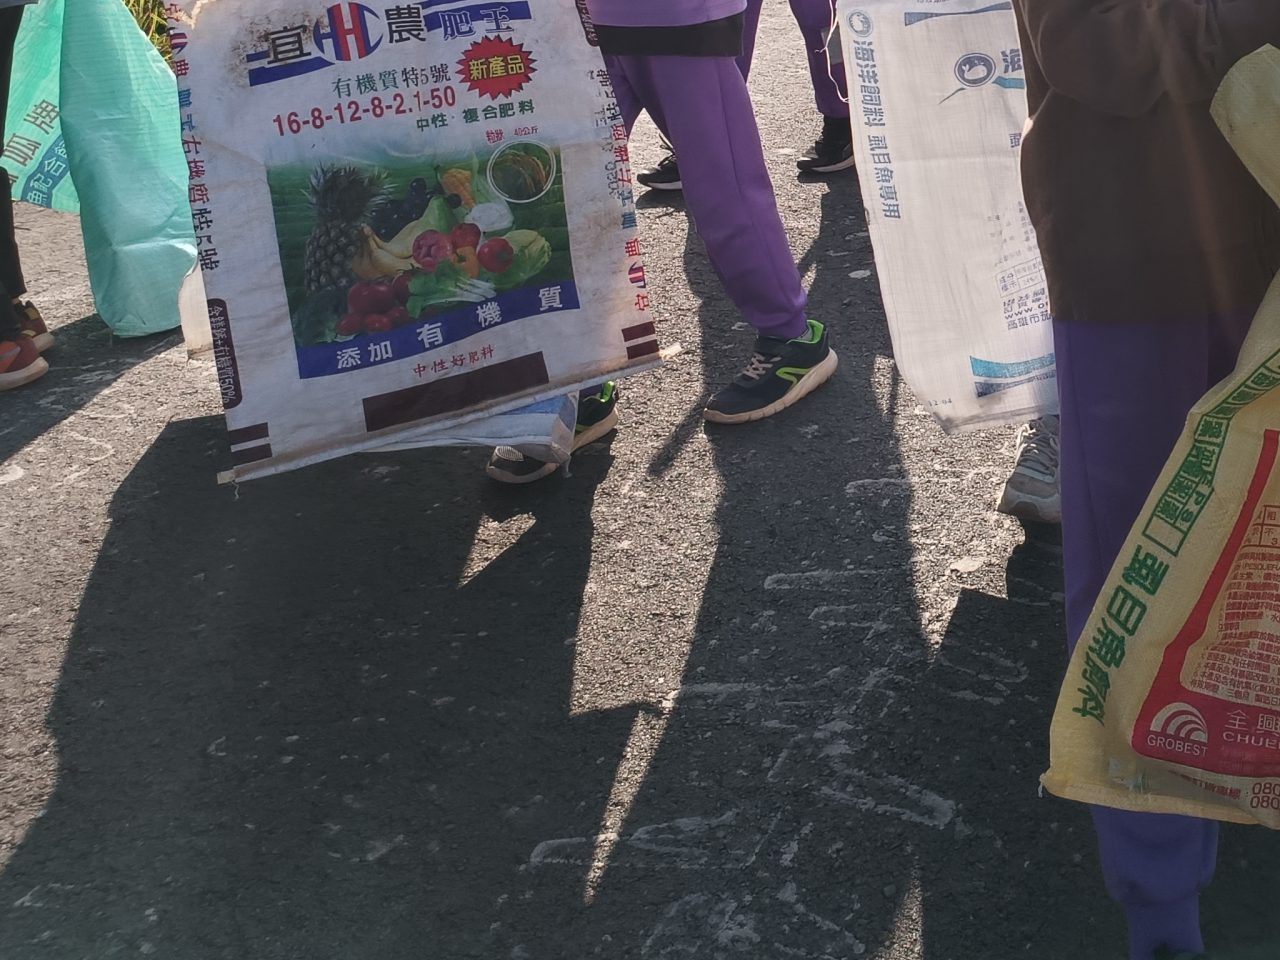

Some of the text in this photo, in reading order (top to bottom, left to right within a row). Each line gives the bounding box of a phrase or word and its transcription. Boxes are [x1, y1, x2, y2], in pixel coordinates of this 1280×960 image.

[332, 63, 451, 99] 有機質特5號
[469, 54, 525, 81] 新產品
[273, 86, 456, 137] 16-8-12-8-2.1-50
[336, 285, 563, 369] 添加有機質
[413, 344, 495, 378] 中性好肥料
[1147, 735, 1208, 758] GROBEST
